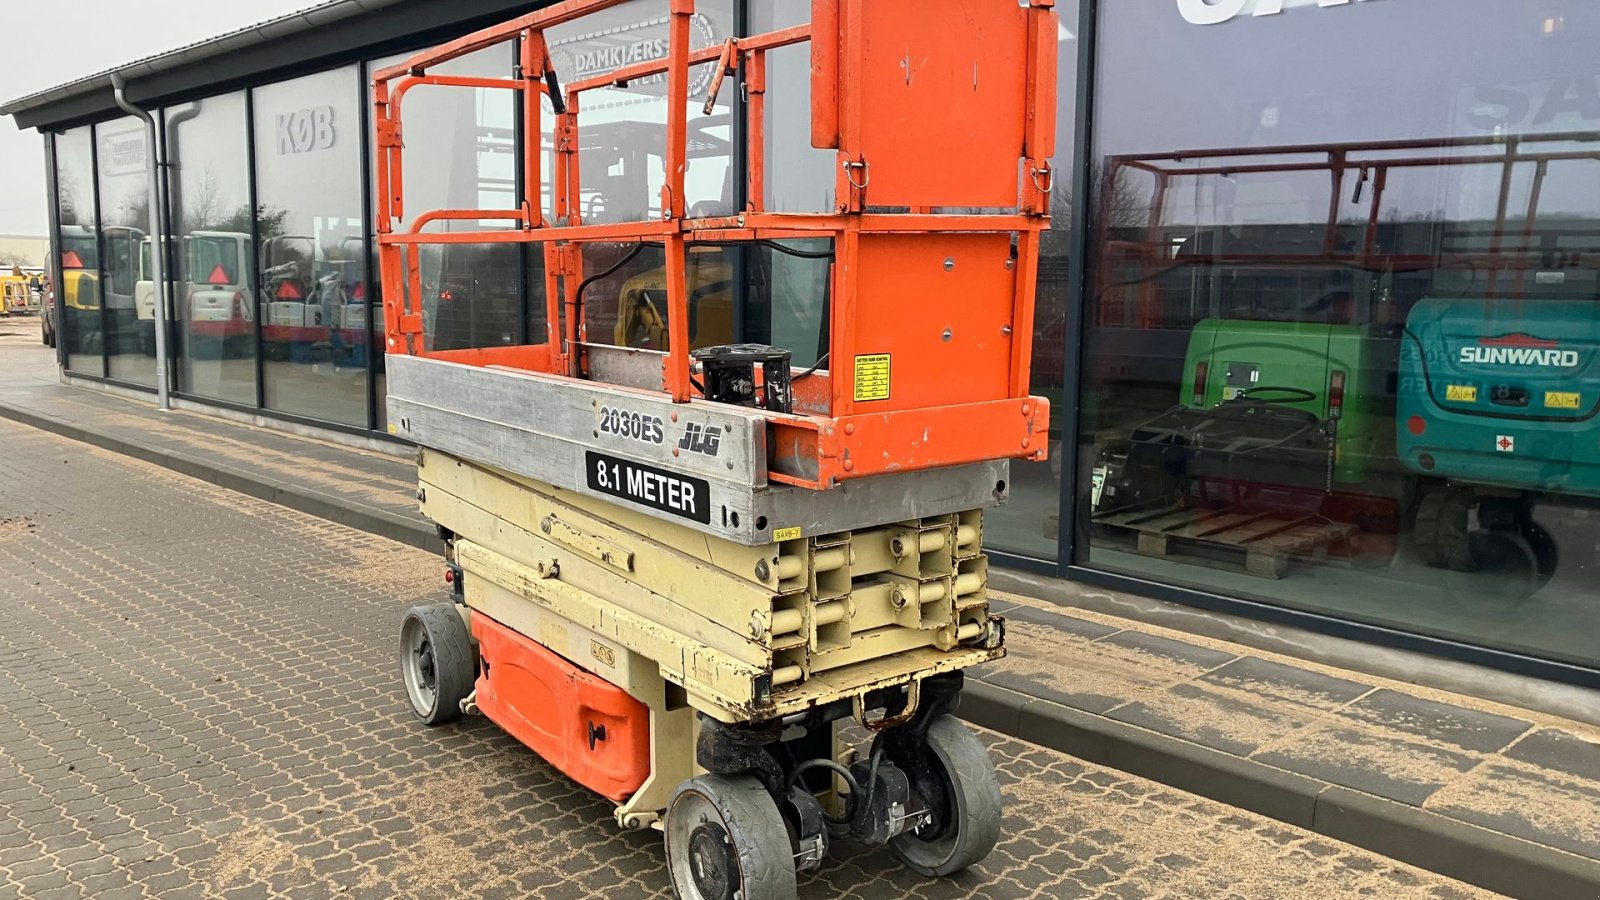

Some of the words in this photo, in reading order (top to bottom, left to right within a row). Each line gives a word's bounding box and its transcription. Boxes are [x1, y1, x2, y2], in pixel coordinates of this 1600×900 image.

[276, 105, 336, 155] KØB
[1459, 347, 1579, 367] SUNWARD
[600, 406, 664, 445] 2030ES
[678, 421, 722, 457] JLG
[597, 460, 621, 491] 8.1
[626, 466, 696, 514] METER
